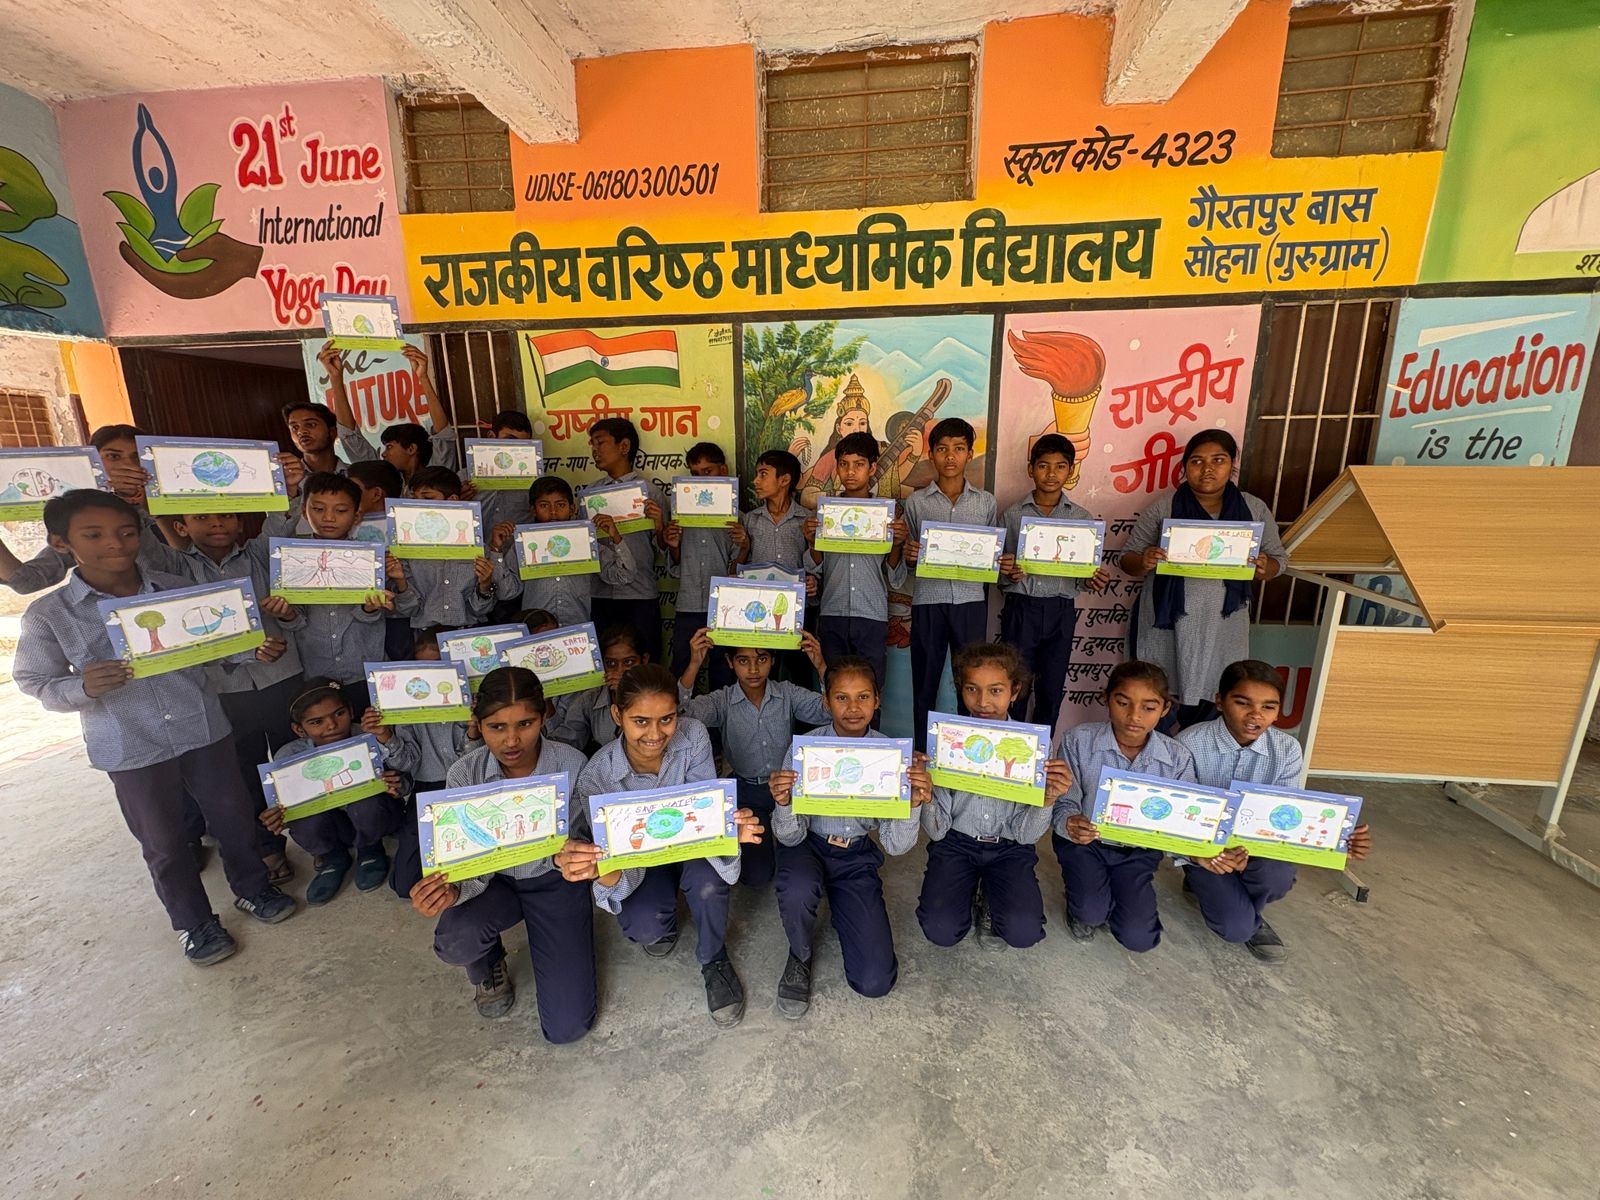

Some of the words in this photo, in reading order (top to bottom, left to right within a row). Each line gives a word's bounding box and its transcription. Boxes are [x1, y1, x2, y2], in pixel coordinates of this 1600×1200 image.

[232, 103, 297, 190] 21st
[300, 138, 382, 185] June
[1003, 138, 1077, 186] स्कूल
[258, 201, 384, 245] International
[1187, 184, 1302, 236] गैरतपुर
[1306, 187, 1379, 225] बास
[420, 231, 582, 309] राजकीय
[585, 226, 726, 302] वरिष्ठ
[731, 212, 955, 296] माध्यमिक
[959, 207, 1162, 288] विद्यालय
[1183, 236, 1261, 283] सोहना
[1265, 226, 1391, 283] (गुरुग्राम)
[260, 268, 325, 325] Yoga
[1109, 342, 1245, 429] राष्ट्रीय
[1390, 332, 1586, 419] Education
[640, 405, 702, 438] गान
[1416, 429, 1451, 460] is
[1465, 427, 1523, 461] the
[562, 636, 588, 647] EARTH
[567, 646, 588, 656] DAY
